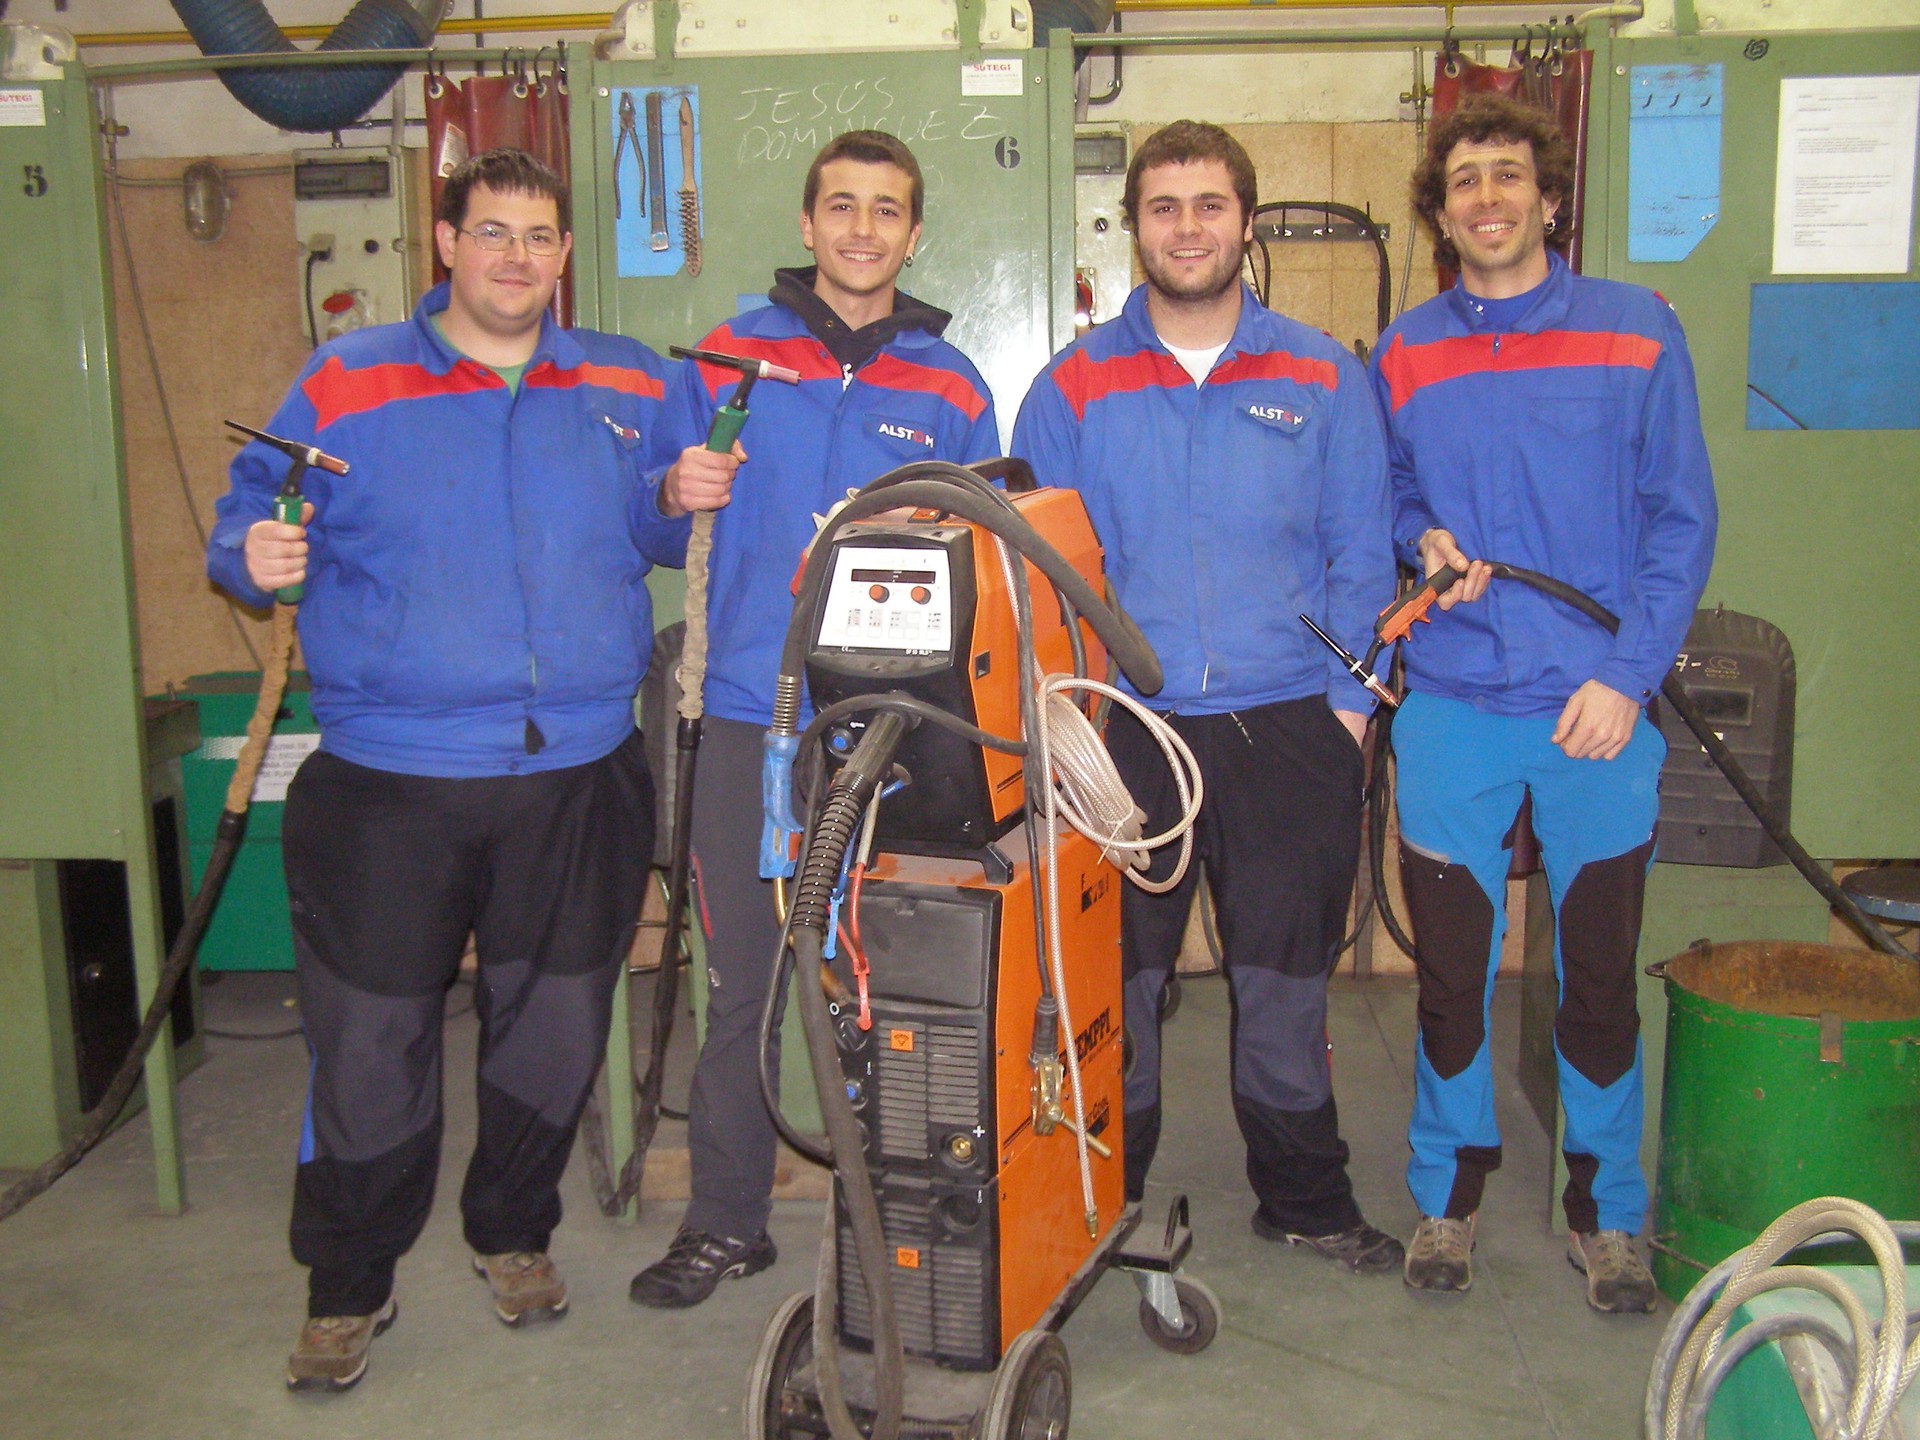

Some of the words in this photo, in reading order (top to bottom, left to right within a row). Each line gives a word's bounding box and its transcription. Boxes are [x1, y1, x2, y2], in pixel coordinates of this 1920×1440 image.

[994, 136, 1021, 169] 6
[23, 165, 48, 198] 5
[878, 423, 935, 449] ALSTOM
